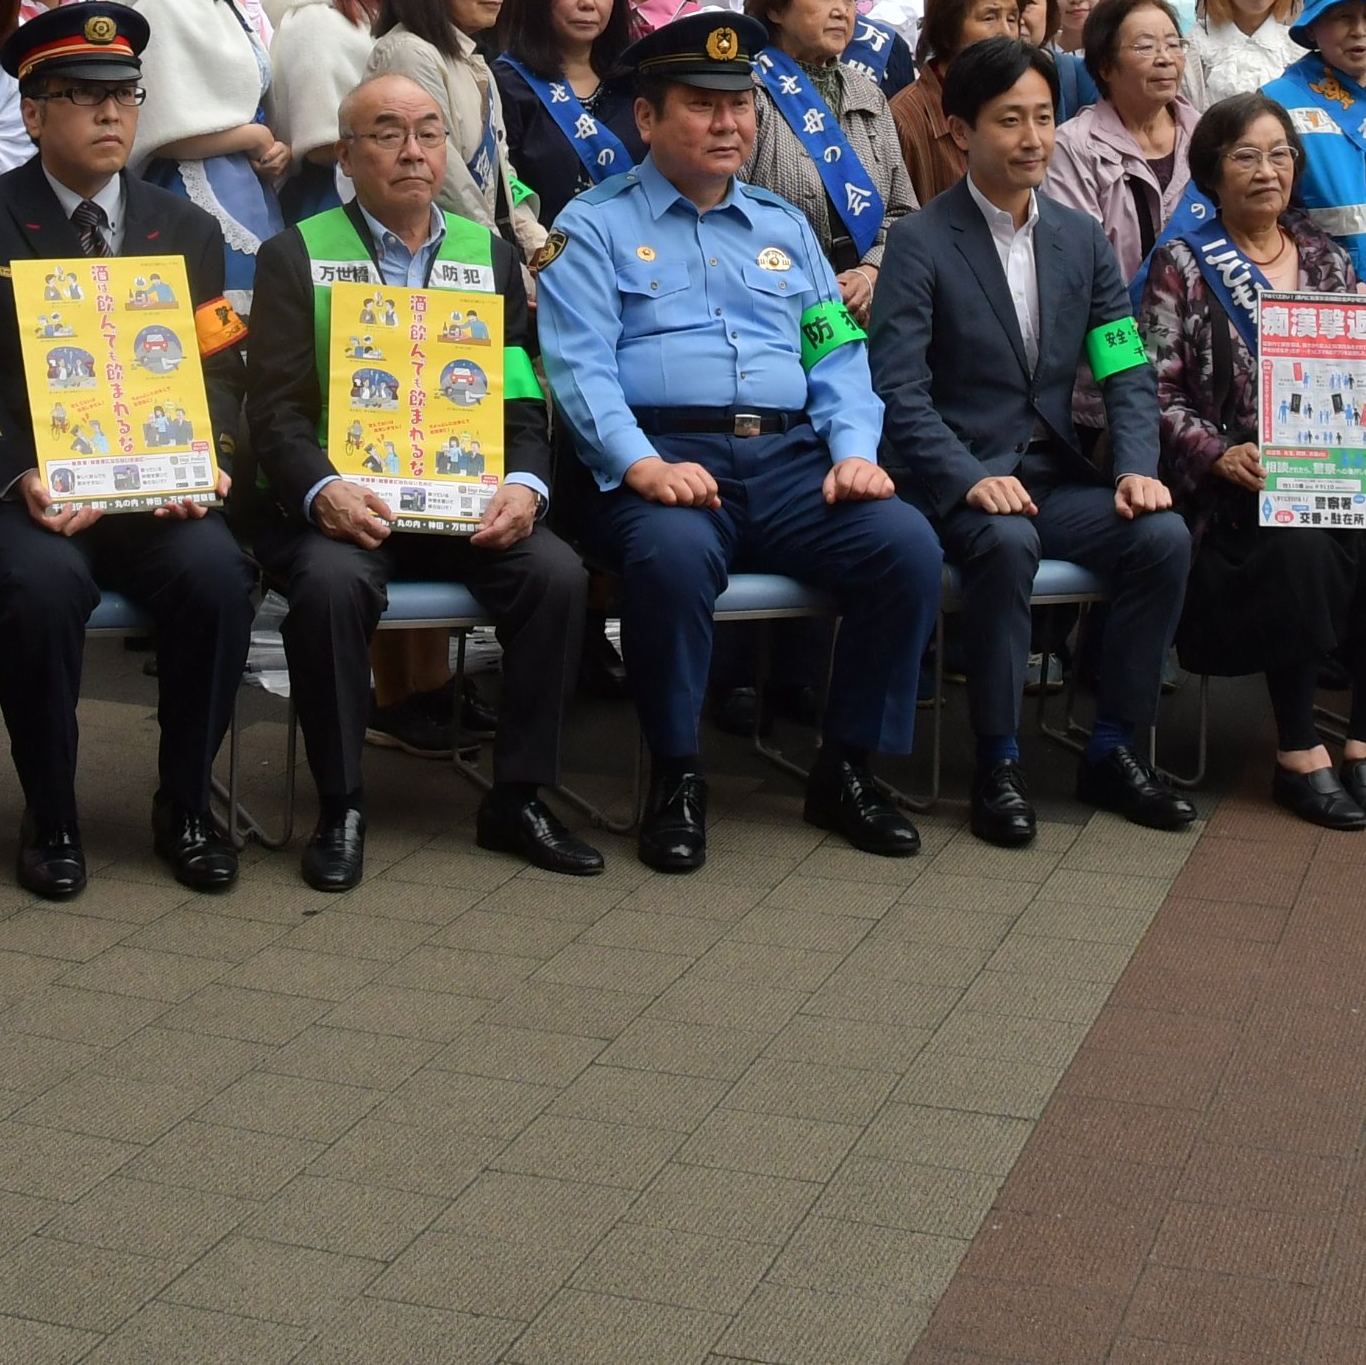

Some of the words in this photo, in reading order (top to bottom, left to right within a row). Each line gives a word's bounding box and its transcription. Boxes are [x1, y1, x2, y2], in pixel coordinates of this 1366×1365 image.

[319, 265, 370, 283] 万世橋
[442, 264, 481, 285] 防犯
[91, 265, 136, 453] 酒は飲んでも飲まれるな
[408, 294, 428, 476] 酒は飲んでも飲まれるな
[1315, 496, 1352, 510] 警察署
[1300, 512, 1365, 525] 交番・駐在所
